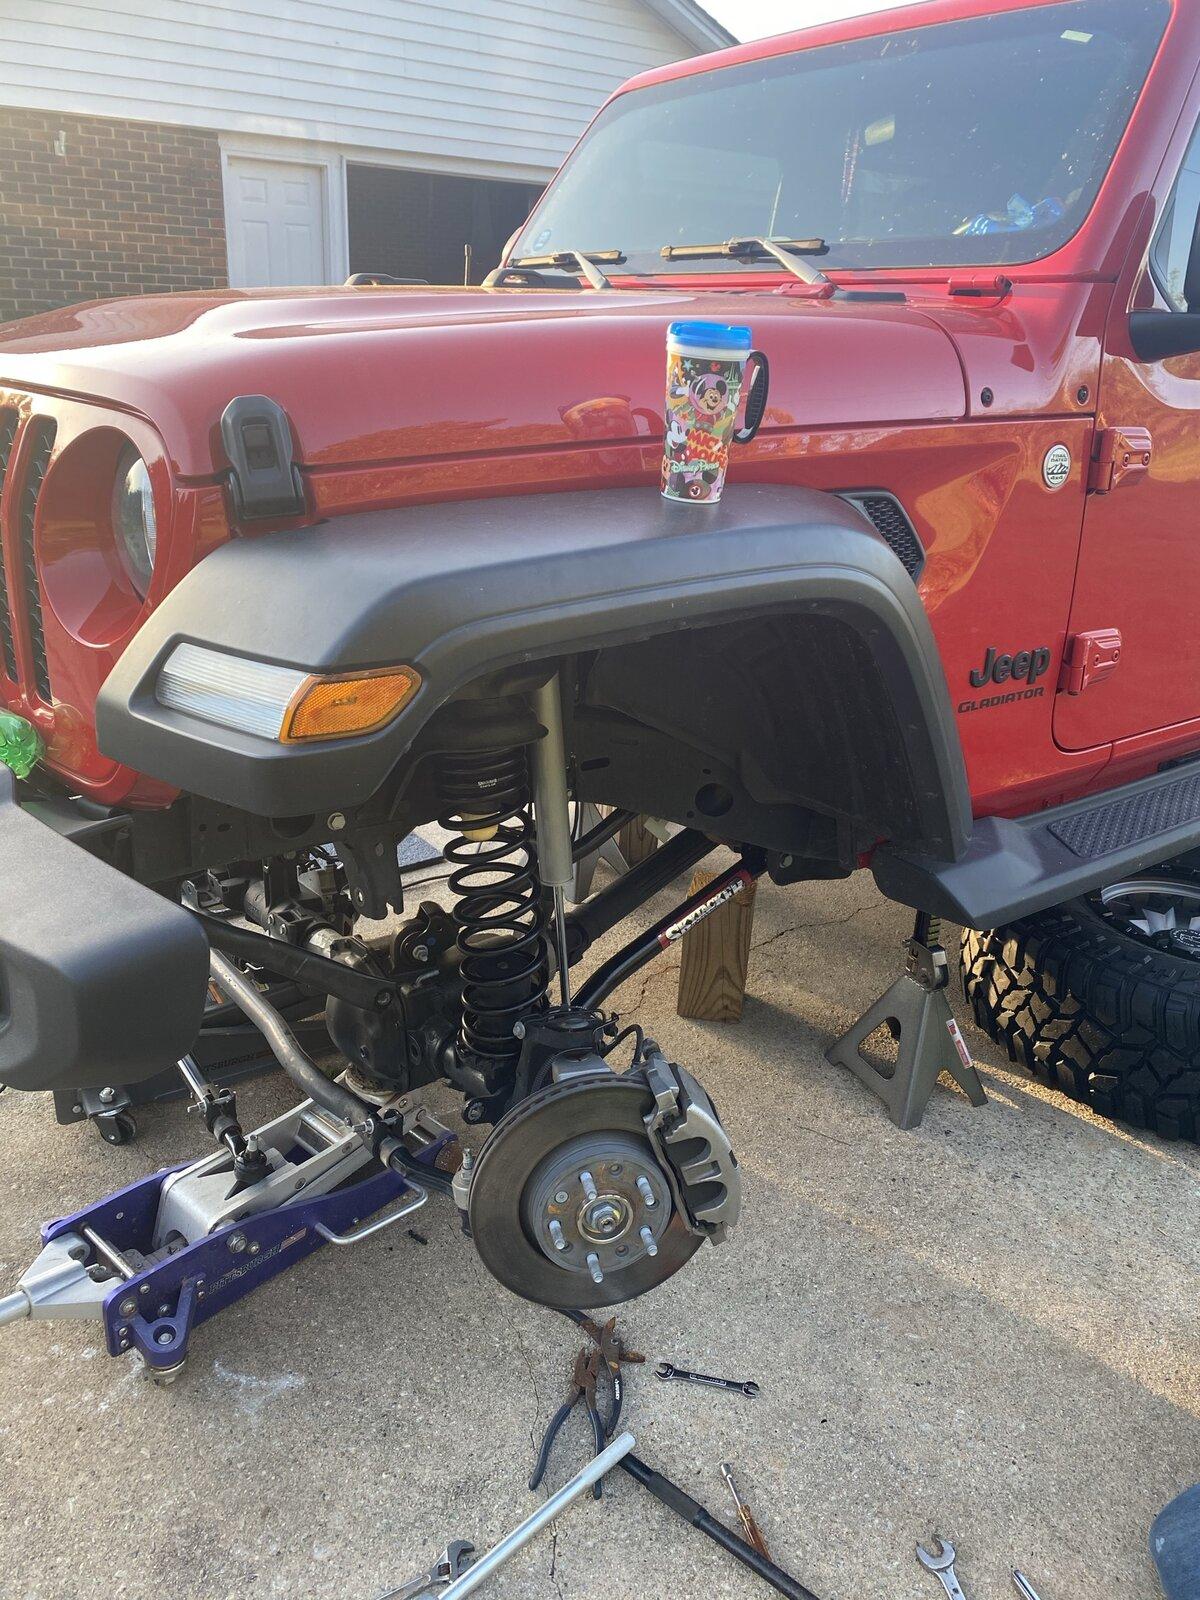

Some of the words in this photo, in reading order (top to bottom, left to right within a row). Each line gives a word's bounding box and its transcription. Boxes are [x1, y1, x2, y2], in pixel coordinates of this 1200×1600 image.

[671, 460, 699, 474] Disney
[969, 646, 1050, 688] Jeep
[958, 687, 1044, 714] GLADIATOR
[208, 1243, 282, 1294] PITTSBURGH
